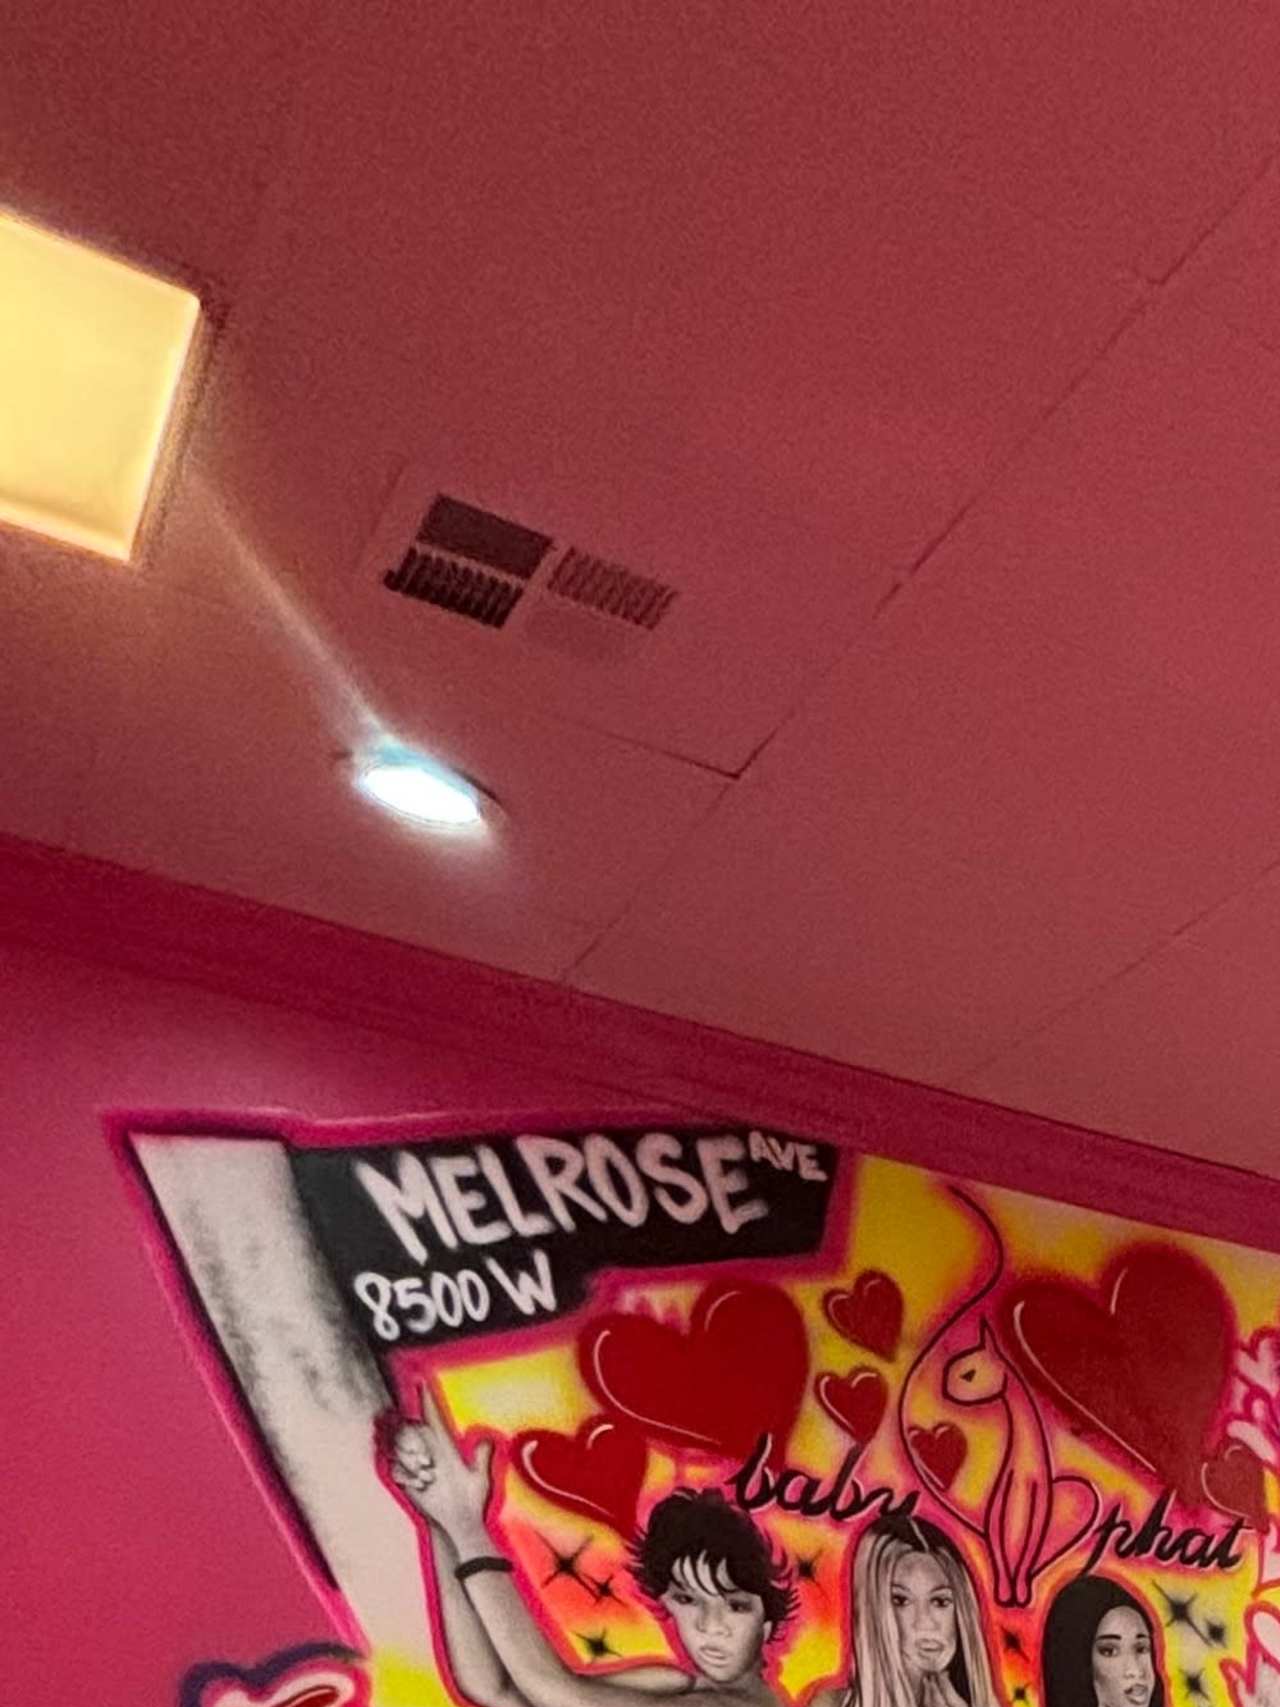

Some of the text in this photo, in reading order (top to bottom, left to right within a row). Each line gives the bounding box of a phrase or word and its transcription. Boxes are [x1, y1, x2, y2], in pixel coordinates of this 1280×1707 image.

[353, 1130, 829, 1264] MELROSE AVE
[353, 1249, 558, 1342] 8500 W
[725, 1432, 1260, 1571] baby phat
